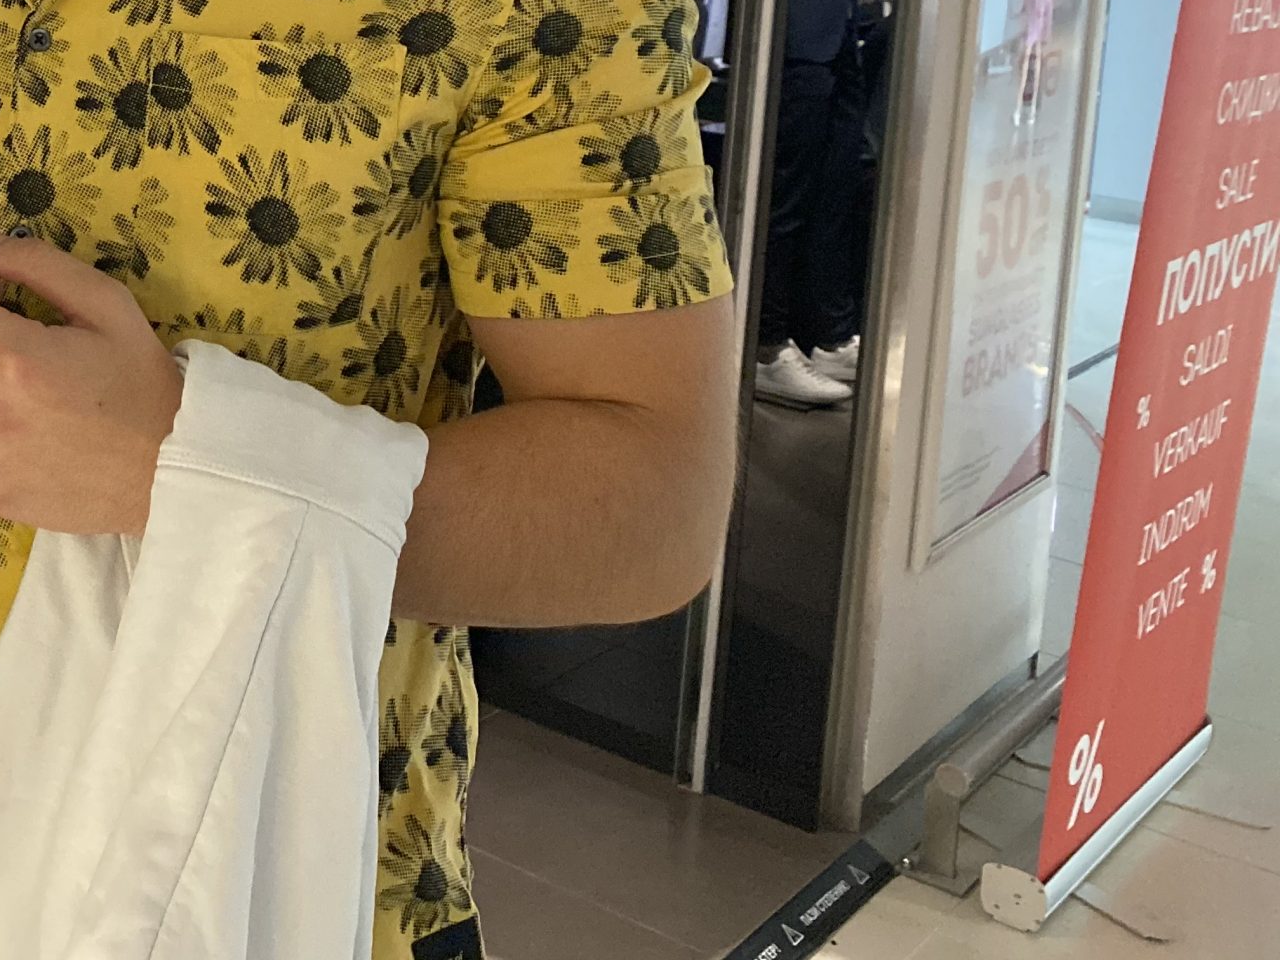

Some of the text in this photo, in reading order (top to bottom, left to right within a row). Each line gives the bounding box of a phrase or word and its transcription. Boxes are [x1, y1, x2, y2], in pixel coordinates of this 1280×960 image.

[1216, 159, 1260, 209] SALE
[1157, 219, 1280, 325] ПОПУСТИ
[1180, 324, 1233, 386] SALDI
[1137, 394, 1151, 430] %
[1153, 399, 1231, 478] VERKAUF
[1138, 483, 1213, 566] INDIRIM
[1137, 549, 1218, 640] VENTE %
[1067, 718, 1105, 831] %
